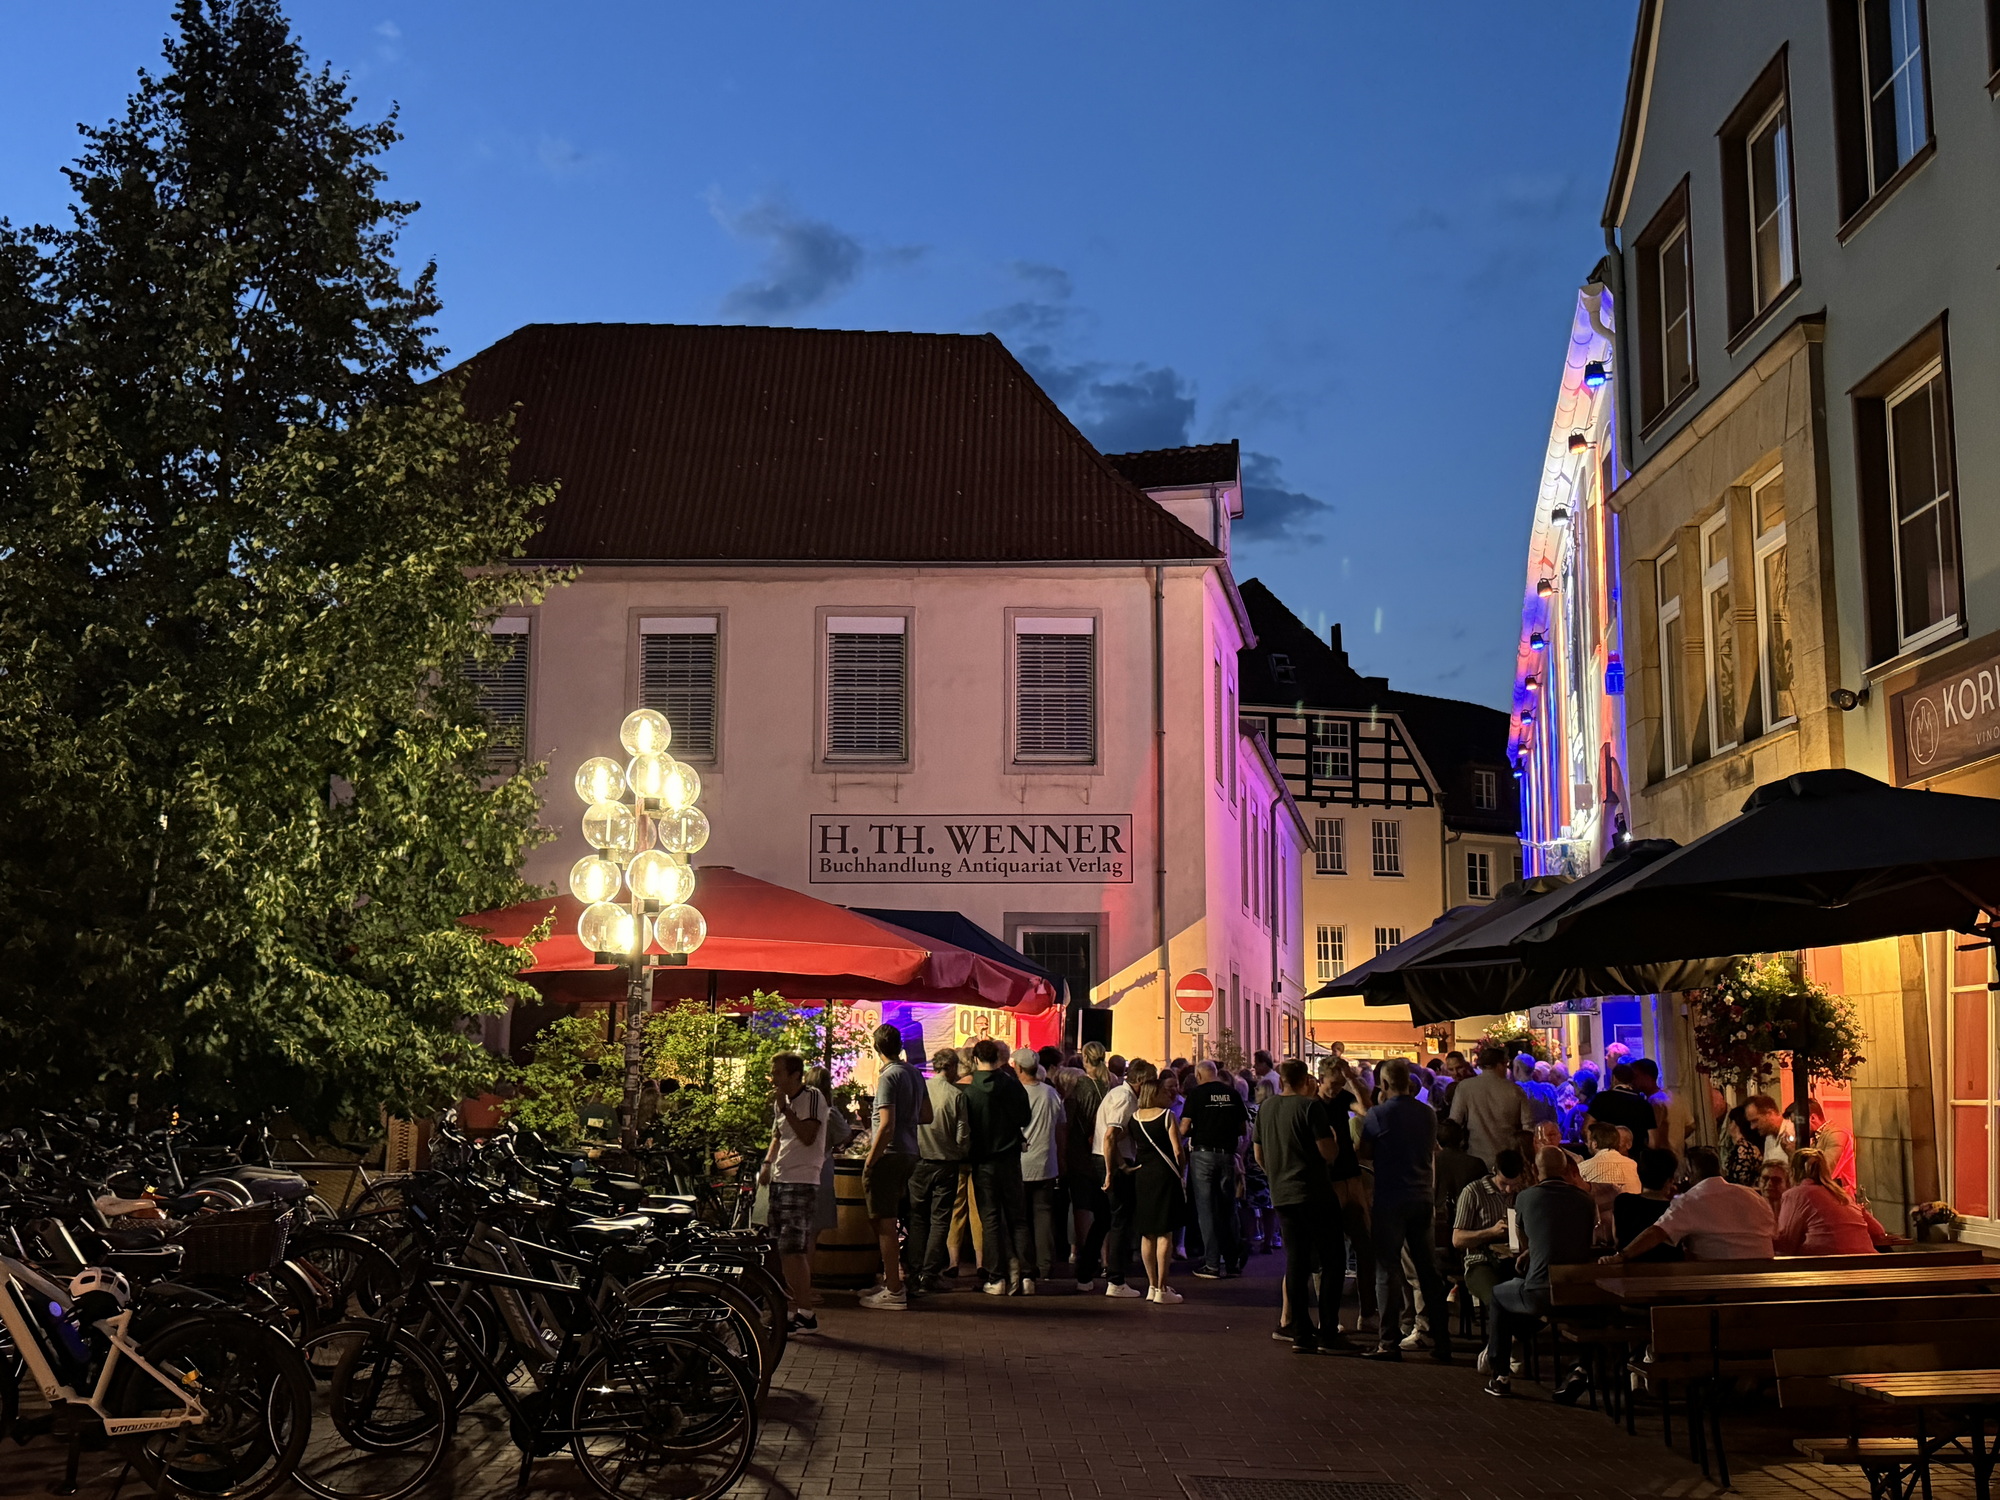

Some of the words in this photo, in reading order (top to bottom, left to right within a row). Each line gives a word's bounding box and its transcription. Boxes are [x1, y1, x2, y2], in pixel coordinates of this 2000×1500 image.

[817, 824, 859, 855] H.
[868, 824, 935, 855] TH.
[944, 824, 1127, 855] WENNER
[819, 856, 952, 877] Buchhandlung
[957, 857, 1063, 878] Antiquariat
[1066, 856, 1124, 877] Verlag
